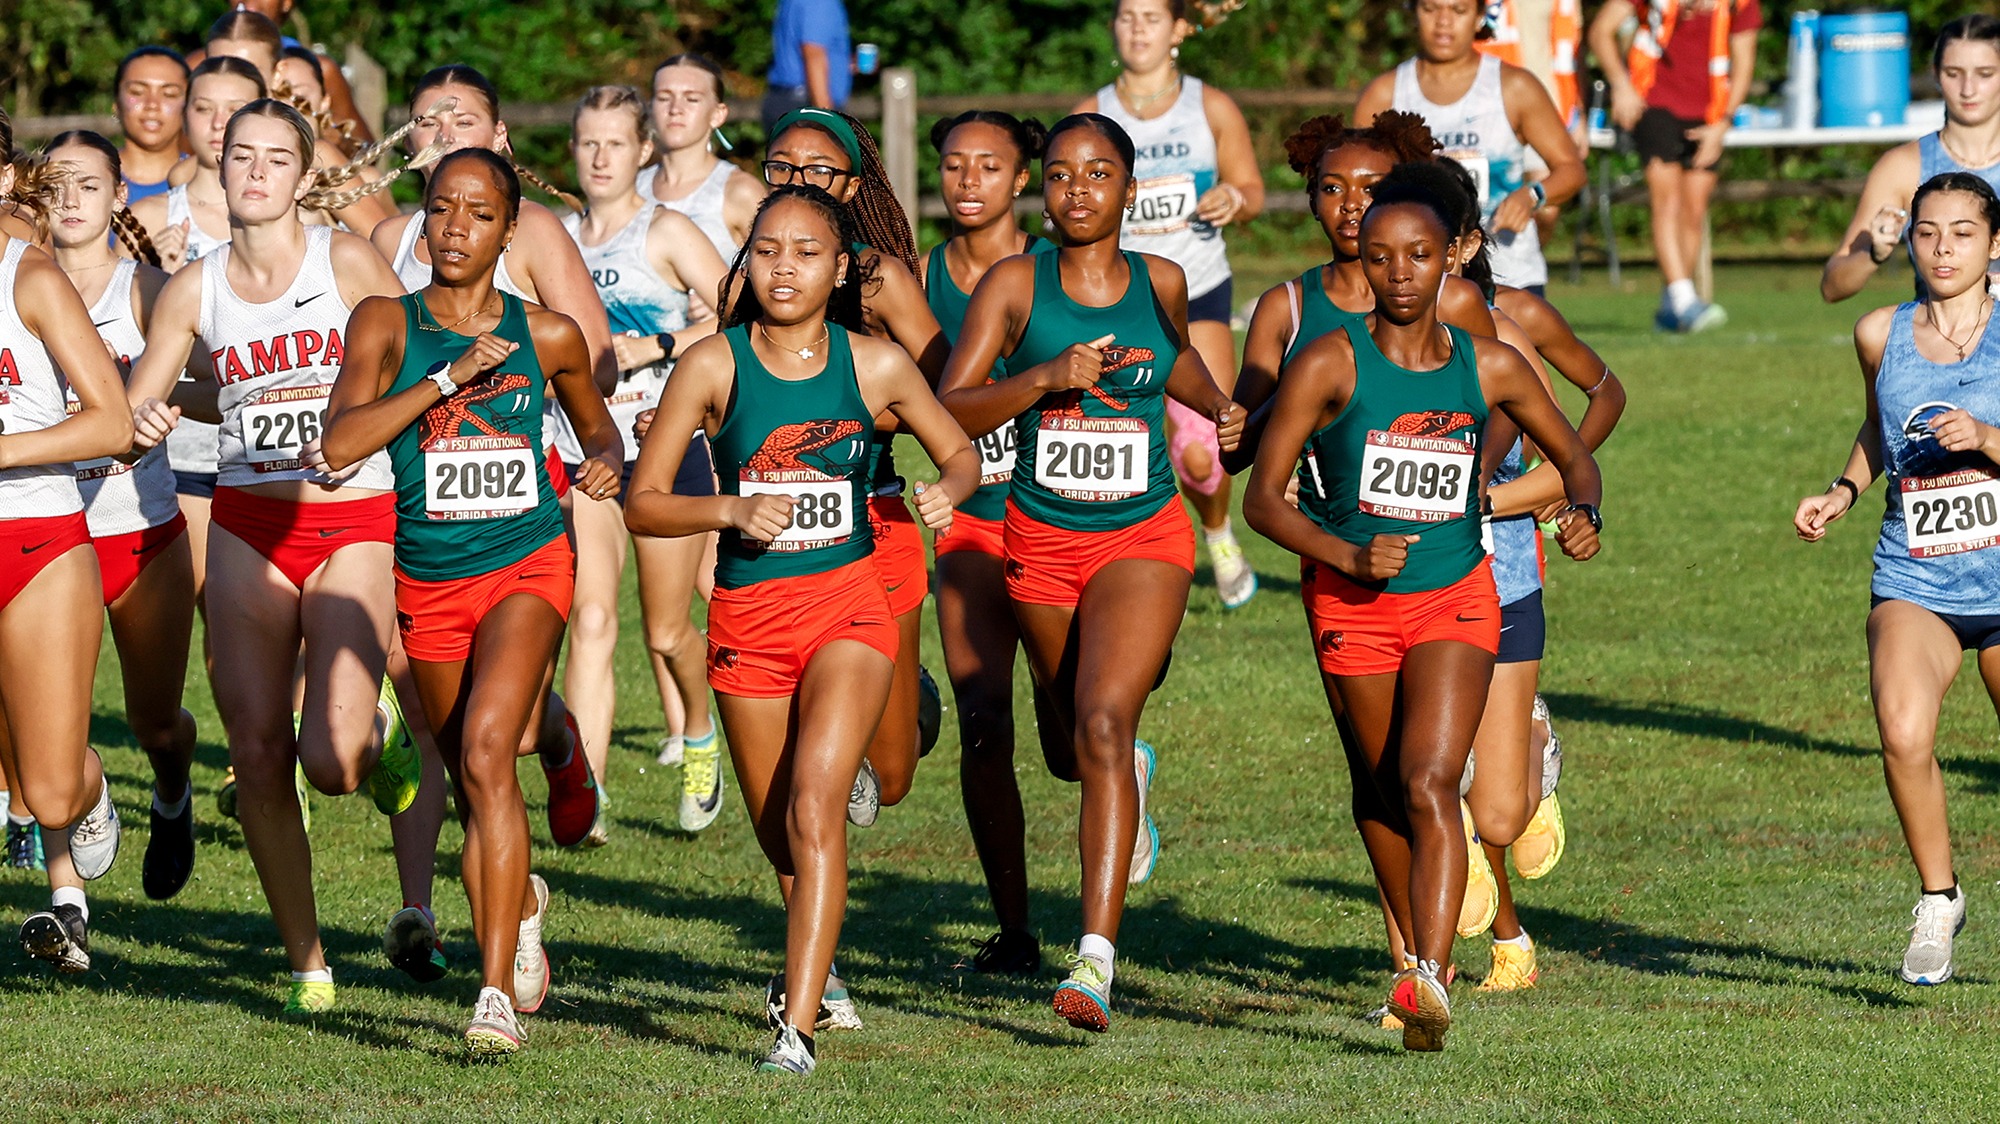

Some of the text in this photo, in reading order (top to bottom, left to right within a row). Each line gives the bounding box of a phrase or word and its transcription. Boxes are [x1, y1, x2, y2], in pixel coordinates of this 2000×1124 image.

[263, 390, 281, 403] FSU
[1063, 418, 1140, 432] FSU INVITATIONAL
[451, 436, 525, 451] FSU INVITATIONAL
[1392, 435, 1468, 453] FSU INVITATIONAL
[1045, 440, 1134, 481] 2091
[94, 463, 125, 478] STATE
[763, 470, 780, 482] FSU
[1369, 456, 1462, 501] 2093
[435, 459, 527, 500] 2092
[1921, 469, 1992, 489] FSU INVITATIONAL
[1098, 491, 1131, 501] STATE
[443, 508, 523, 520] FLORIDA STATE
[1373, 504, 1451, 521] FLORIDA STATE
[1912, 491, 1998, 537] 2230
[803, 538, 835, 550] STATE
[1923, 536, 1997, 557] FLORIDA STATE
